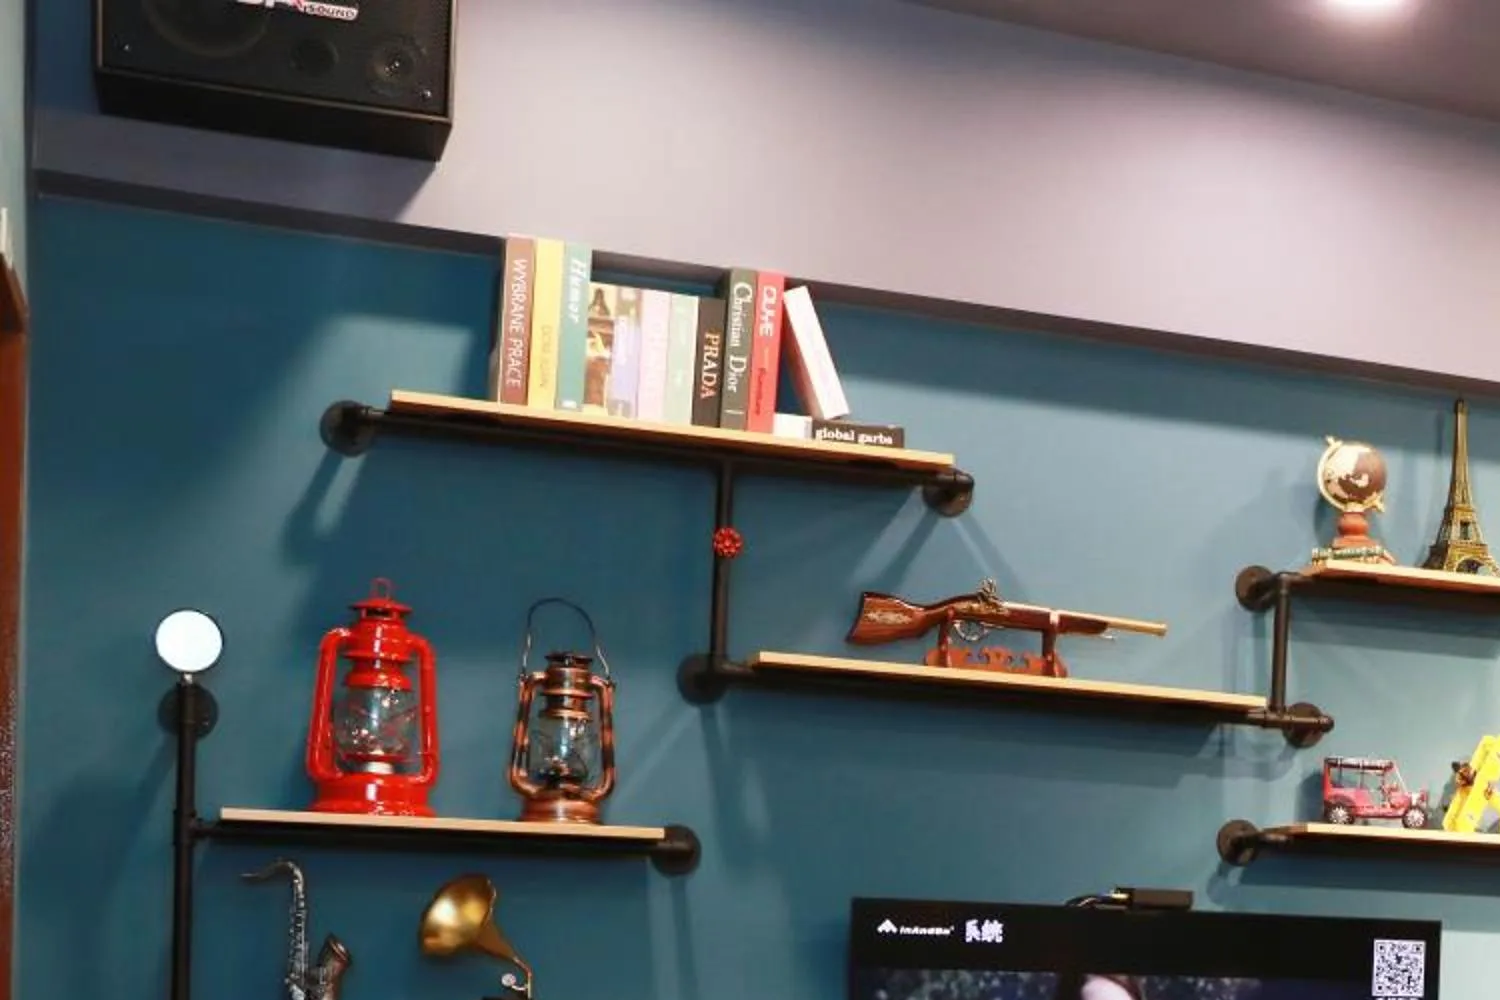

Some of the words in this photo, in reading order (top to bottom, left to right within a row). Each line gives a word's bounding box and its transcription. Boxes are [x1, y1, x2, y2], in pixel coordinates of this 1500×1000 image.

[509, 259, 529, 334] WYBRANE
[506, 338, 523, 389] PRACE
[701, 333, 721, 399] PRADA
[728, 356, 748, 393] Dior
[815, 428, 855, 441] global
